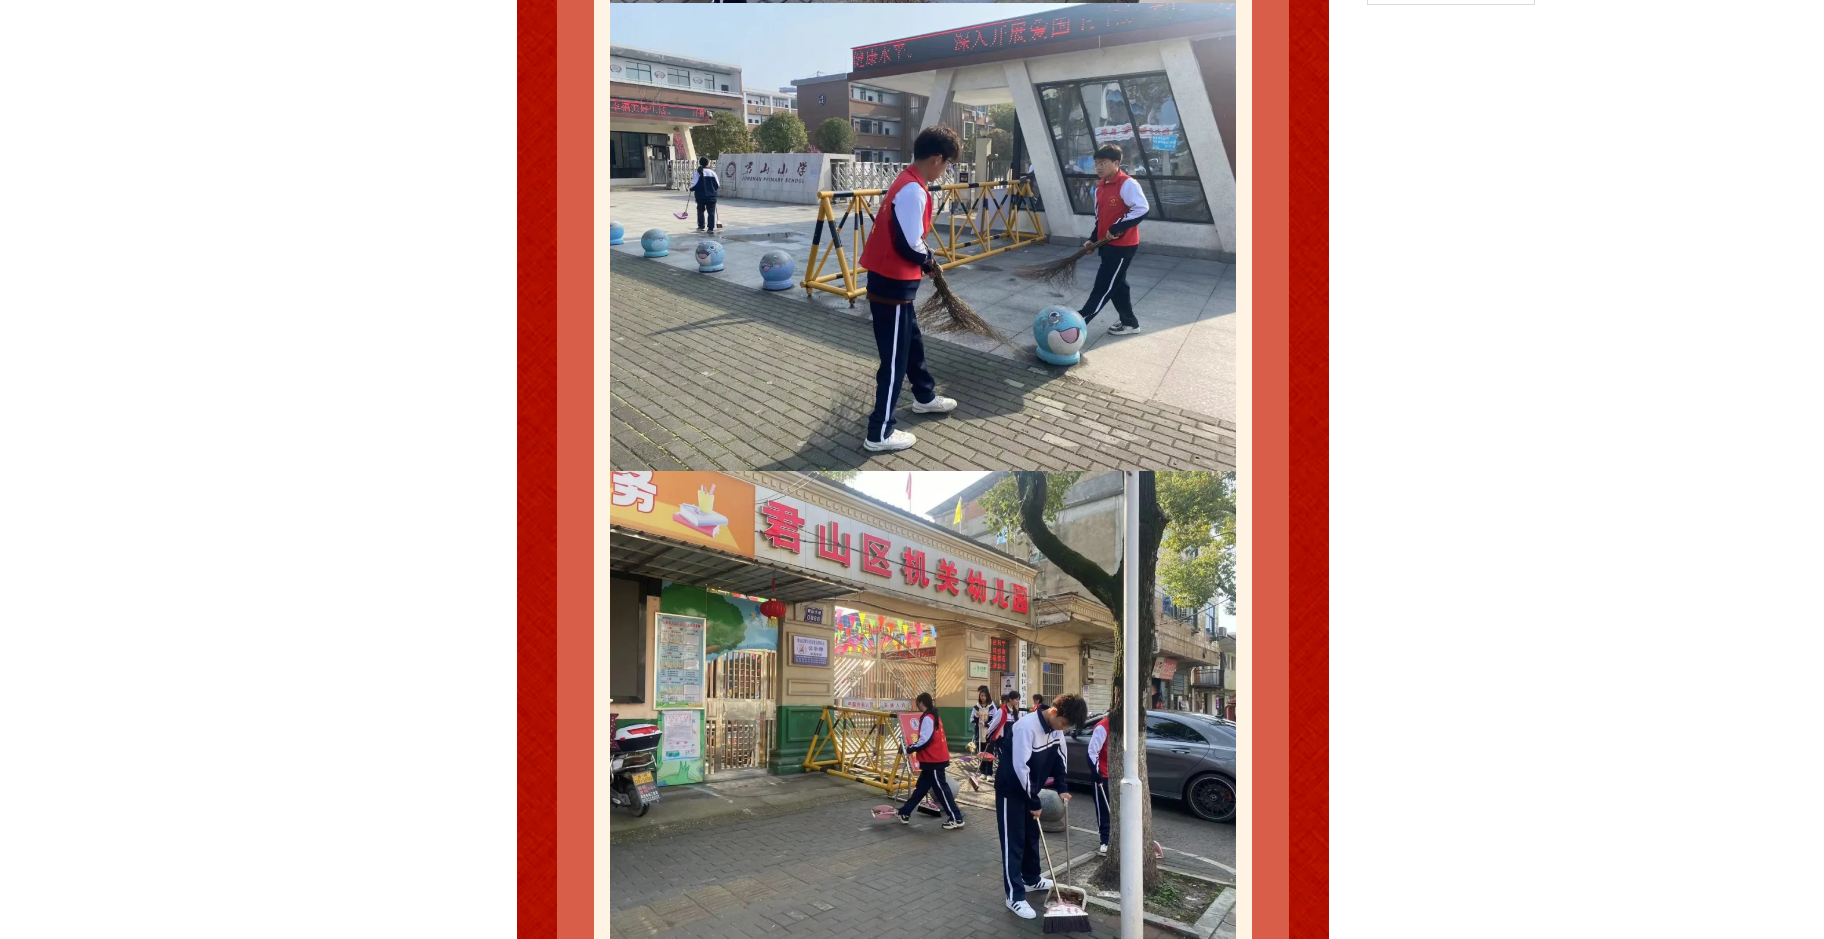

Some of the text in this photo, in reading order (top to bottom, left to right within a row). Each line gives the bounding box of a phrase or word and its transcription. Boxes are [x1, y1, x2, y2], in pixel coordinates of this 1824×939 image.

[743, 161, 808, 177] 君山小学
[611, 471, 658, 514] 务
[761, 499, 1028, 615] 君山区机关幼儿园
